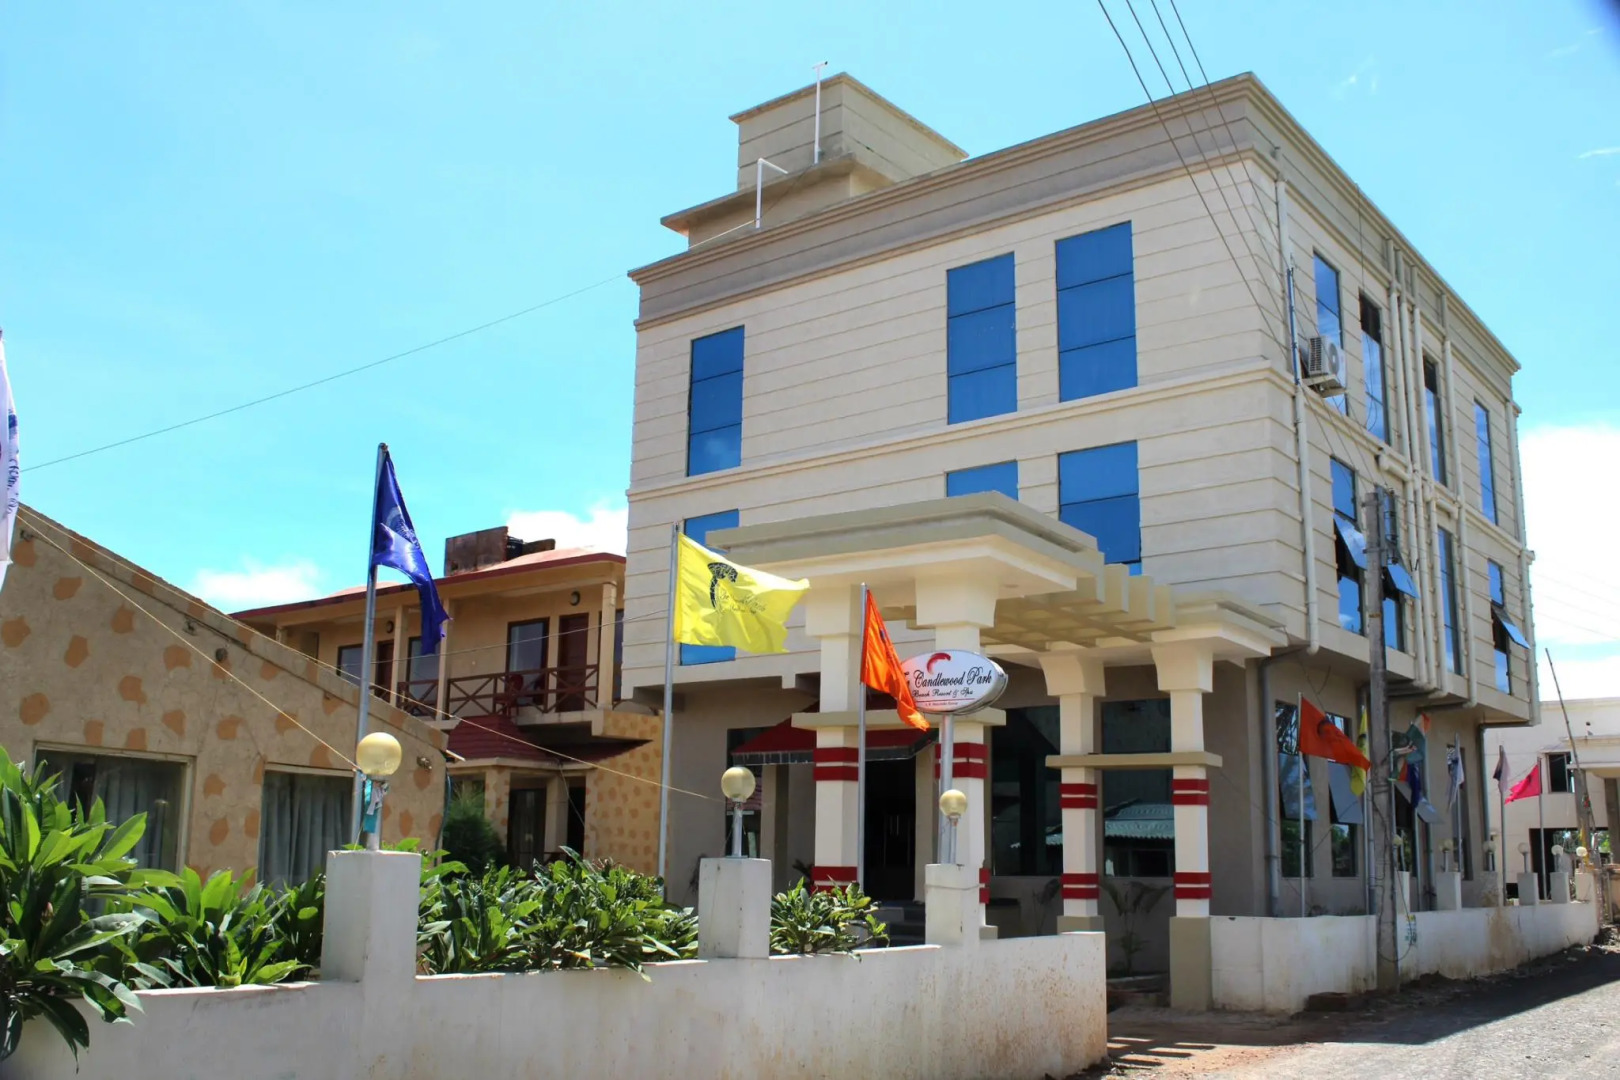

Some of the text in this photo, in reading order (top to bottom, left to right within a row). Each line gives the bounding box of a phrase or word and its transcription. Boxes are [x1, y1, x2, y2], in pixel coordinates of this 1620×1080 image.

[913, 670, 966, 688] Candlewood
[967, 666, 992, 685] Park
[932, 689, 952, 697] Resort
